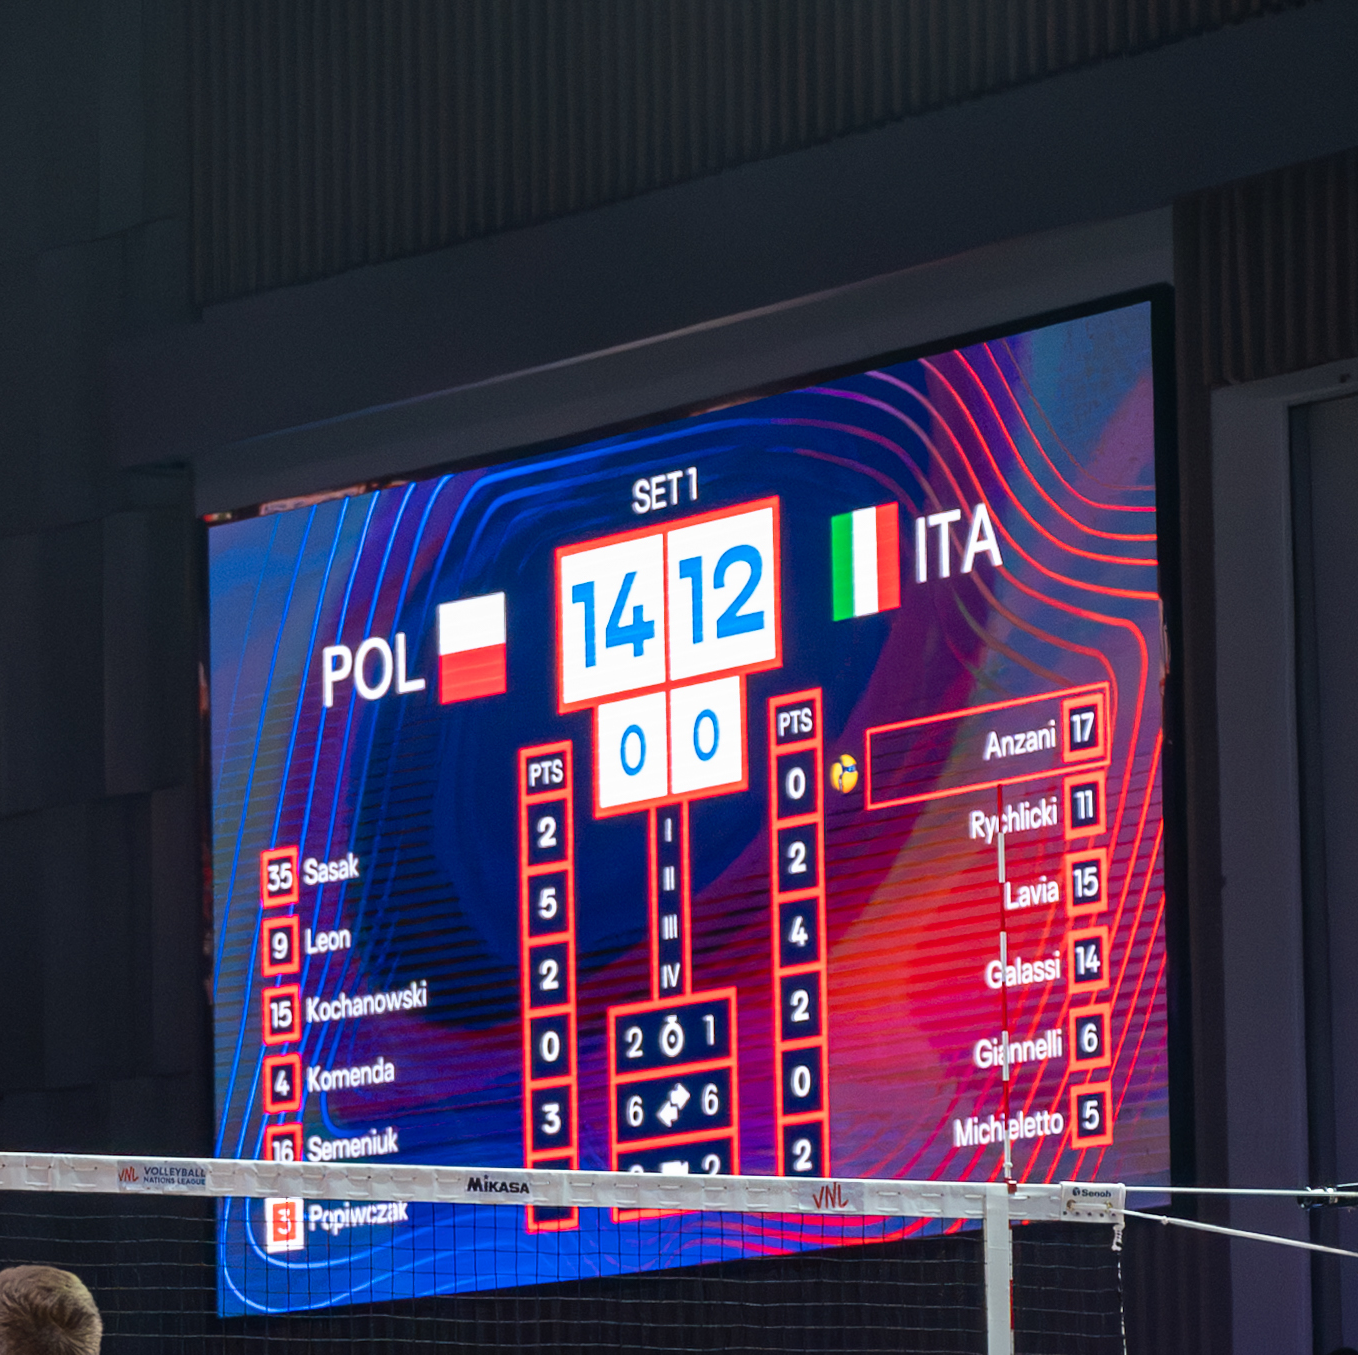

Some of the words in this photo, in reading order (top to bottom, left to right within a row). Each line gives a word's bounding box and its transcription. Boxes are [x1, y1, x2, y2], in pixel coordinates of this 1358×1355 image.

[631, 470, 683, 515] SET
[688, 467, 698, 501] 1
[915, 502, 1004, 584] ITA
[571, 570, 655, 668] 14
[678, 543, 766, 645] 12
[322, 631, 426, 708] POL
[778, 707, 813, 737] PTS
[982, 719, 1056, 761] Anzani
[1071, 711, 1095, 743] 17
[619, 724, 647, 776] 0
[693, 708, 720, 762] 0
[528, 758, 564, 788] PTS
[785, 766, 807, 799] 0
[537, 815, 557, 848] 2
[969, 796, 1058, 844] Rychlicki
[1072, 789, 1094, 820] 11
[266, 863, 294, 893] 35
[303, 852, 360, 885] Sasak
[787, 840, 808, 874] 2
[538, 887, 558, 919] 5
[1003, 876, 1059, 911] Lavia
[1073, 866, 1100, 898] 15
[271, 932, 289, 961] 9
[304, 927, 351, 956] Leon
[788, 915, 809, 947] 4
[539, 958, 560, 991] 2
[660, 961, 681, 989] IV
[986, 950, 1061, 990] Galassi
[1074, 944, 1101, 975] 14
[270, 1001, 293, 1029] 15
[306, 980, 428, 1023] Kochanowski
[789, 988, 810, 1023] 2
[539, 1030, 561, 1062] 0
[624, 1026, 644, 1059] 2
[702, 1014, 716, 1046] 1
[974, 1028, 1063, 1069] Giannelli
[1082, 1023, 1098, 1053] 6
[274, 1069, 290, 1098] 4
[307, 1056, 396, 1092] Komenda
[790, 1065, 811, 1098] 0
[541, 1102, 562, 1135] 3
[625, 1094, 644, 1127] 6
[701, 1083, 720, 1116] 6
[953, 1109, 1065, 1148] Michieletto
[1082, 1100, 1100, 1130] 5
[272, 1139, 294, 1162] 16
[307, 1128, 399, 1162] Semeniuk
[792, 1138, 813, 1172] 2
[118, 1166, 139, 1182] VNL
[143, 1166, 206, 1178] VOLLEYBALL
[143, 1176, 175, 1185] NATIONS
[177, 1178, 206, 1186] LEAGUE
[813, 1181, 849, 1210] VNL
[1082, 1187, 1112, 1199] Senoh
[275, 1203, 292, 1236] 3
[308, 1200, 409, 1236] Popiwczak
